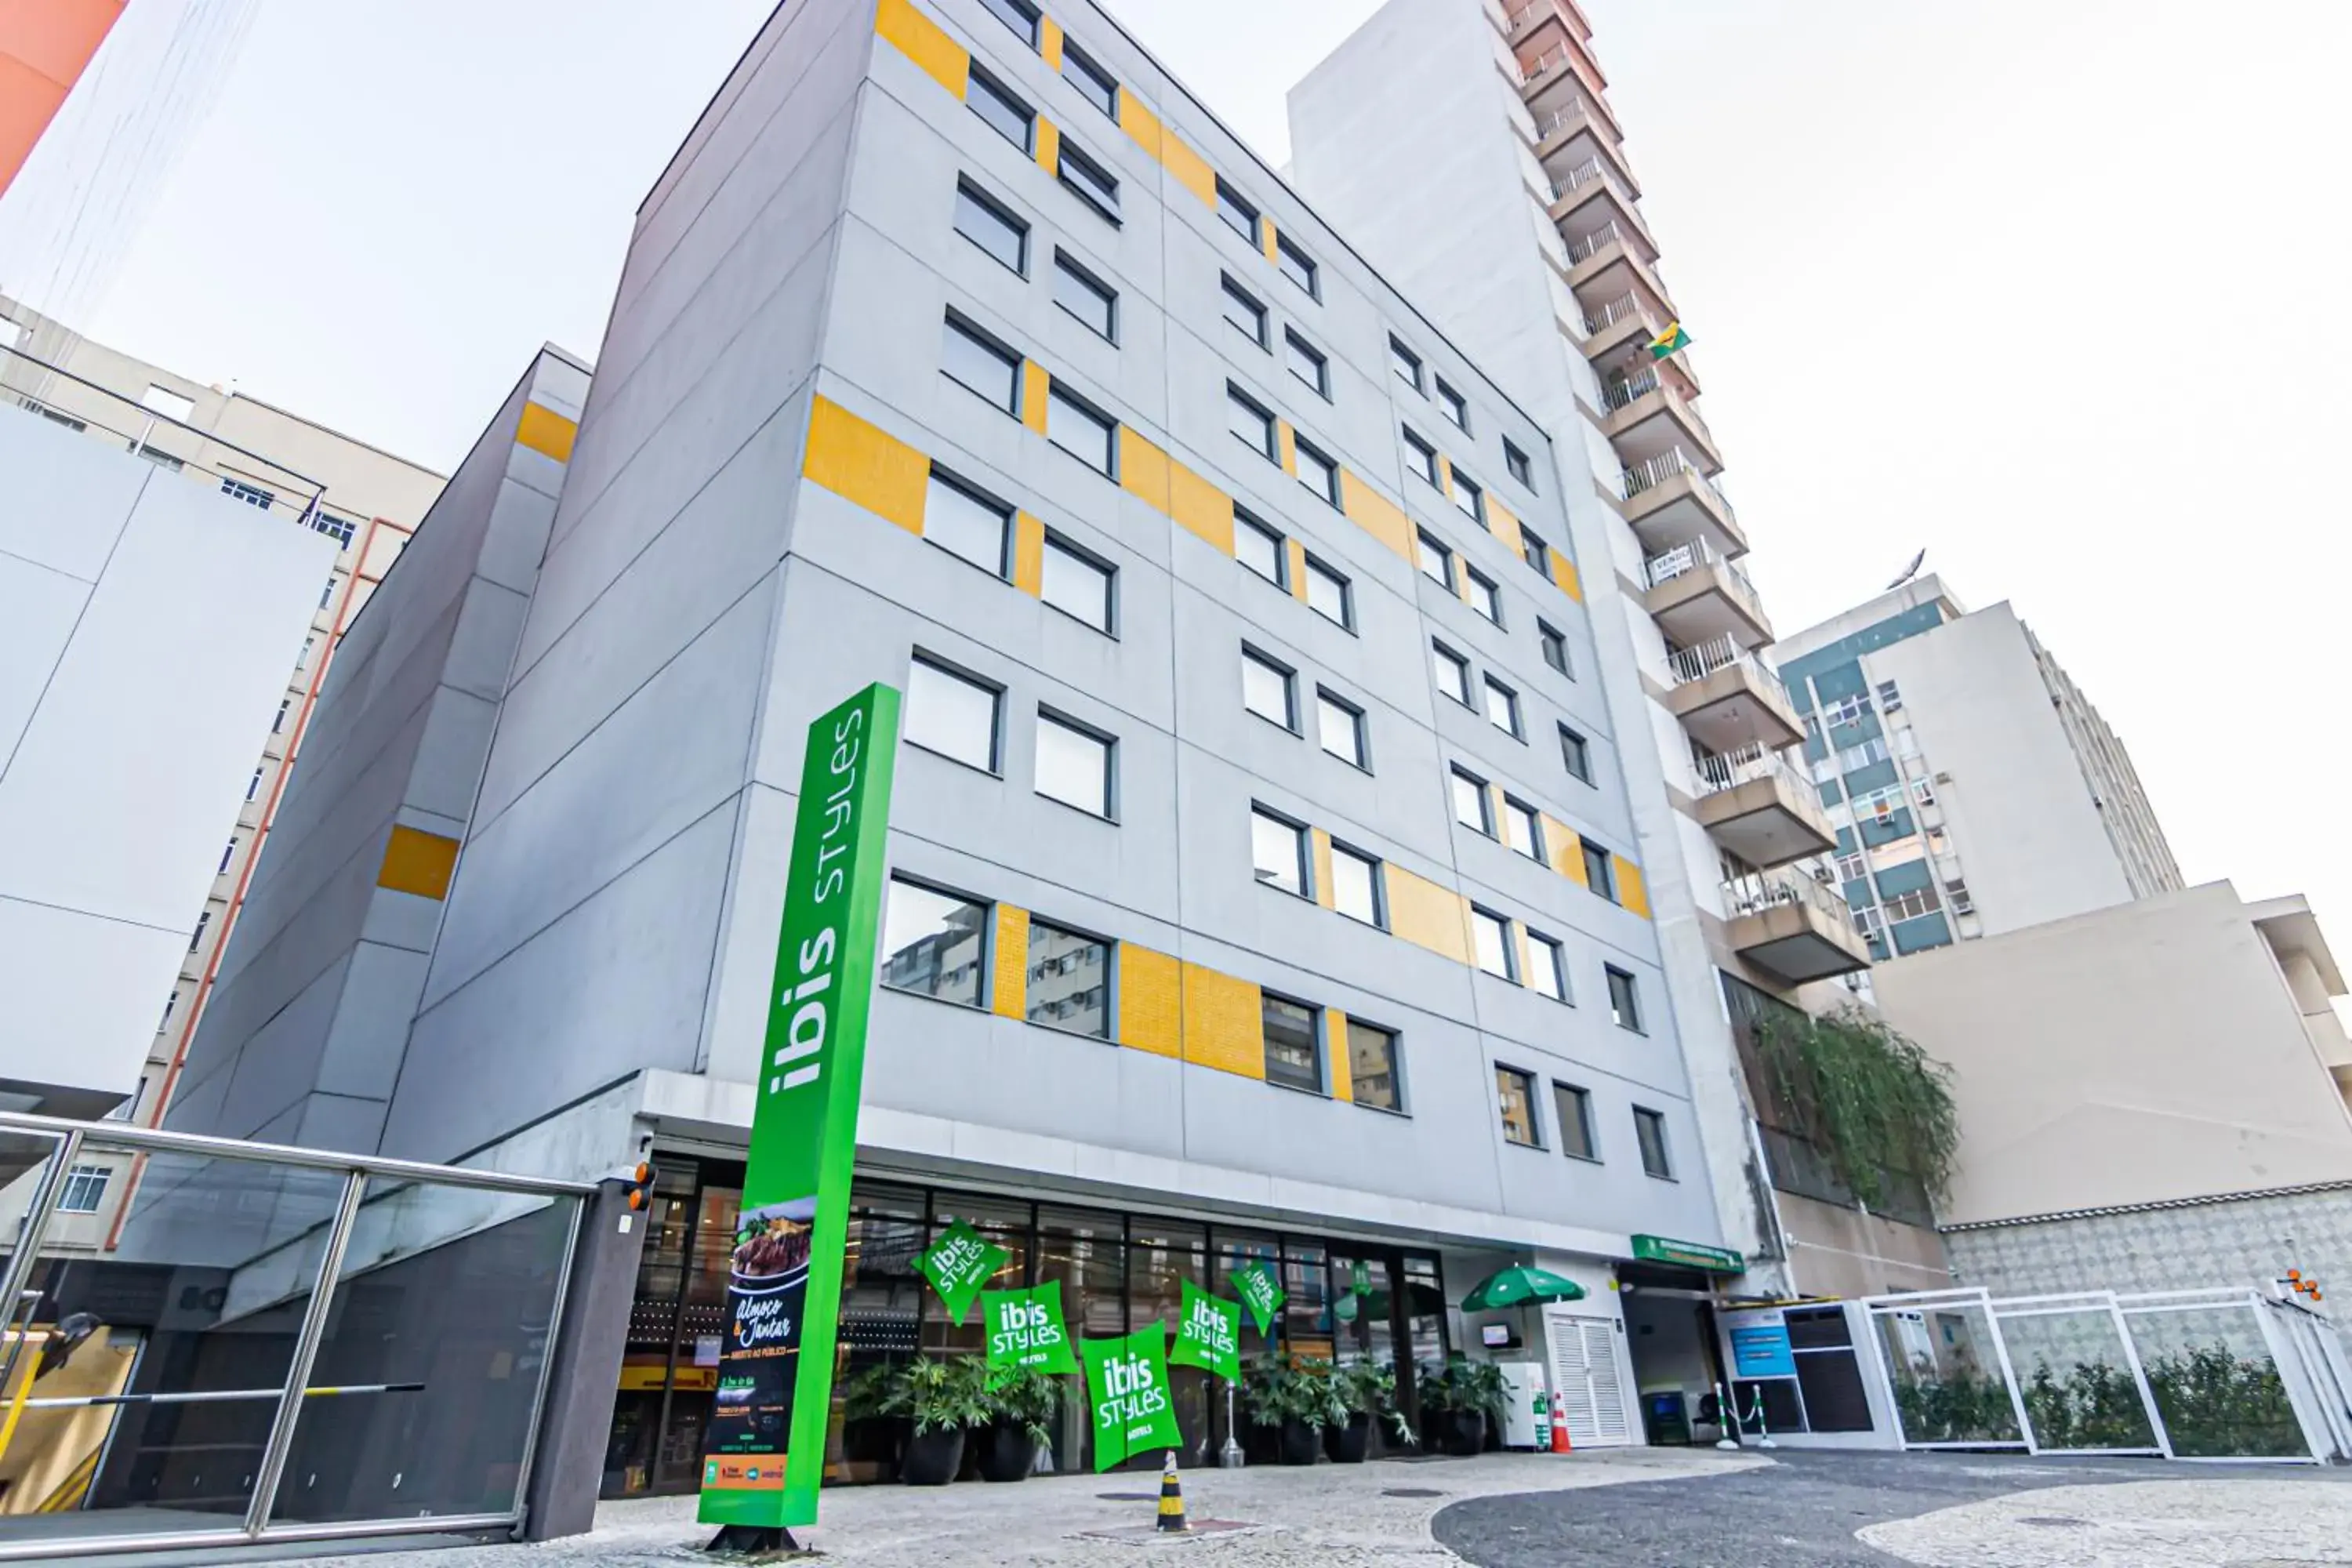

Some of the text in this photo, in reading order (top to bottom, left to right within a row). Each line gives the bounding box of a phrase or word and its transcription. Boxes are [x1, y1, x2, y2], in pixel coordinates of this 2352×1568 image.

[770, 927, 836, 1094] ibis
[931, 1236, 969, 1274] ibis
[1000, 1299, 1048, 1331] ibis
[1193, 1298, 1229, 1334] ibis
[1104, 1352, 1153, 1398] ibis
